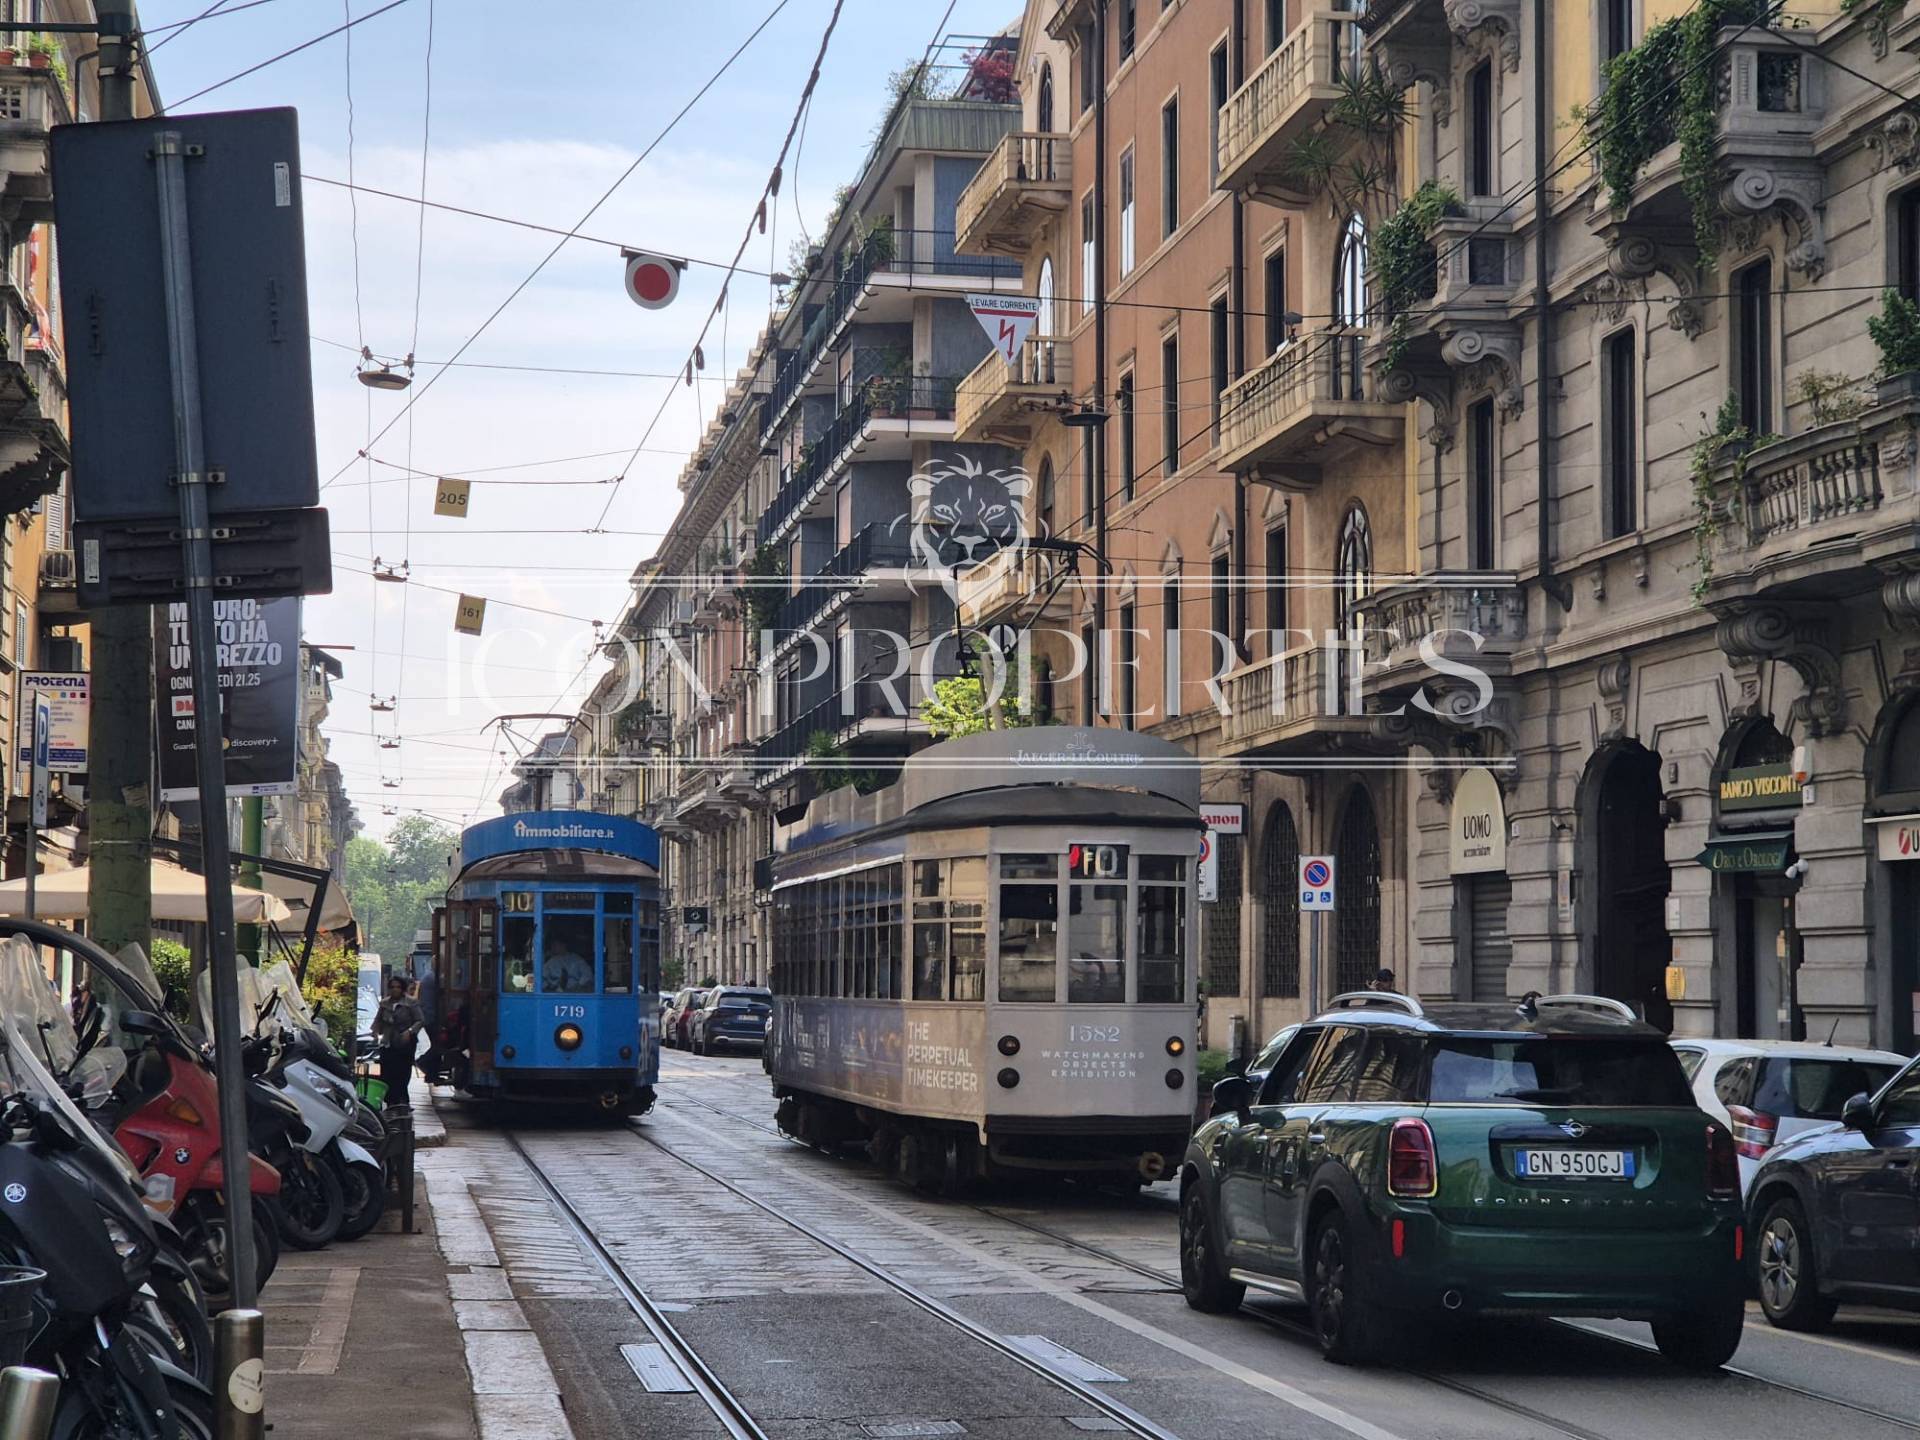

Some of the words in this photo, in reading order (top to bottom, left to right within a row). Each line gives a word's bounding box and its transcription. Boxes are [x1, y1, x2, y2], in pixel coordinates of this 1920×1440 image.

[970, 299, 998, 308] LEVARE
[1000, 300, 1037, 311] CORRENTE
[439, 492, 467, 506] 205
[462, 607, 480, 619] 161
[240, 620, 269, 642] HA
[216, 643, 282, 667] REZZO
[235, 672, 261, 686] 21.25
[231, 737, 279, 747] discovery+
[1720, 779, 1753, 800] BANCO
[1201, 814, 1241, 825] anon
[1463, 813, 1492, 840] UOMO
[554, 1004, 585, 1018] 1719
[907, 1021, 930, 1041] THE
[1069, 1024, 1120, 1042] 1582
[907, 1044, 972, 1068] PERPETUAL
[1040, 1050, 1145, 1060] WATCHMAKING
[1062, 1060, 1126, 1069] OBJECTS
[907, 1067, 978, 1093] TIMEKEEPER
[1050, 1069, 1137, 1079] EXHIBITION
[1529, 1152, 1553, 1174] GN
[1559, 1152, 1621, 1174] 950GJ
